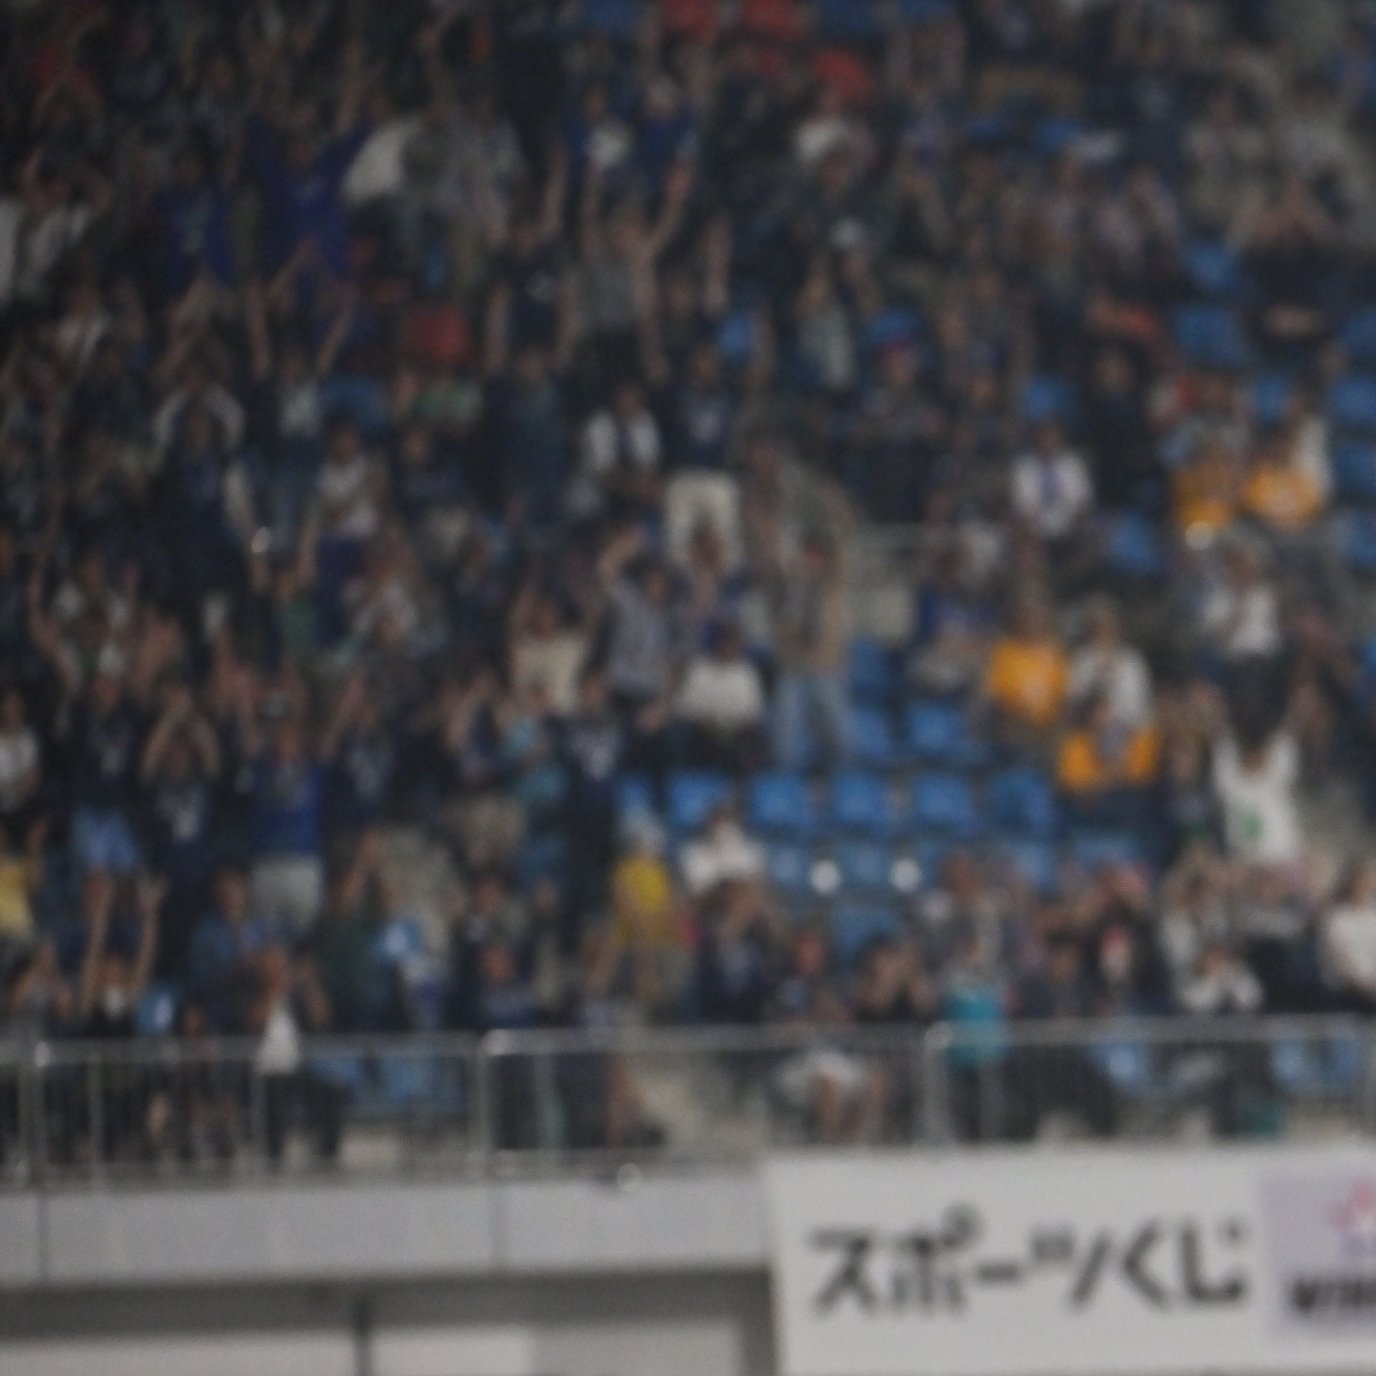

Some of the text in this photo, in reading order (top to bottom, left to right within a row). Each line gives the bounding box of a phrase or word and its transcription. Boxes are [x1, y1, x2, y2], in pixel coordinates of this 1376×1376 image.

[808, 1203, 1247, 1312] スポーツくじ
